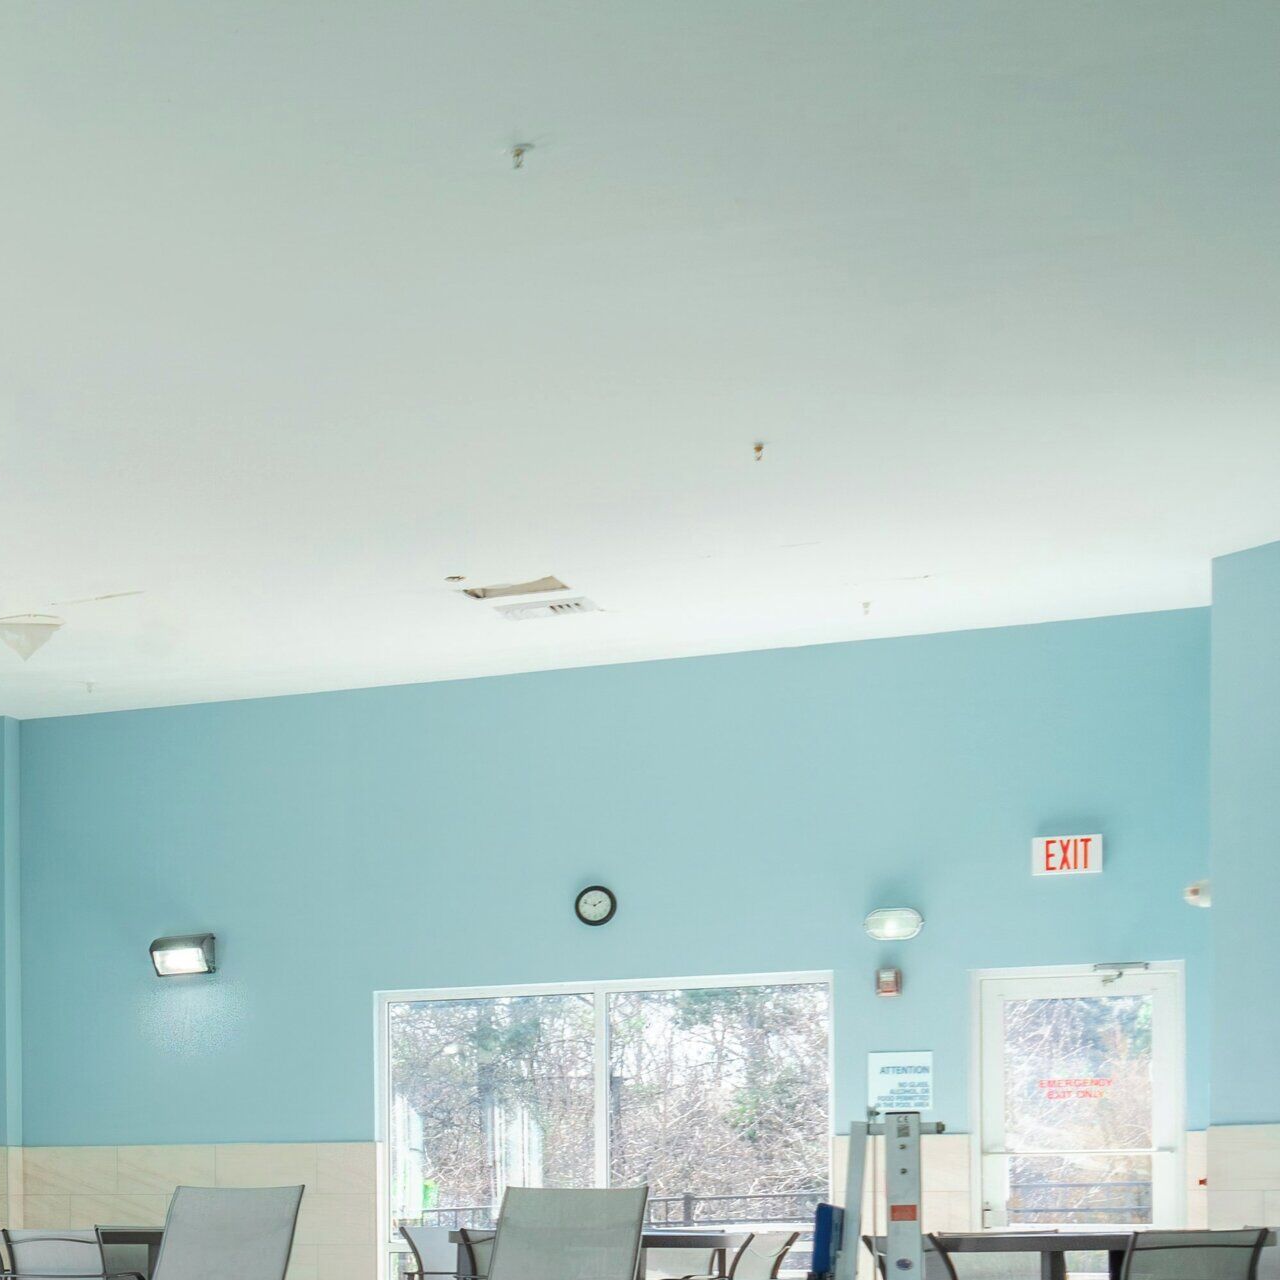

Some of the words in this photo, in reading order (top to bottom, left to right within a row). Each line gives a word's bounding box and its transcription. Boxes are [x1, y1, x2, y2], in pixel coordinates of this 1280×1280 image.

[1045, 837, 1092, 871] EXIT
[880, 1065, 930, 1075] ATTENTION
[1039, 1079, 1113, 1088] EMERGENCY
